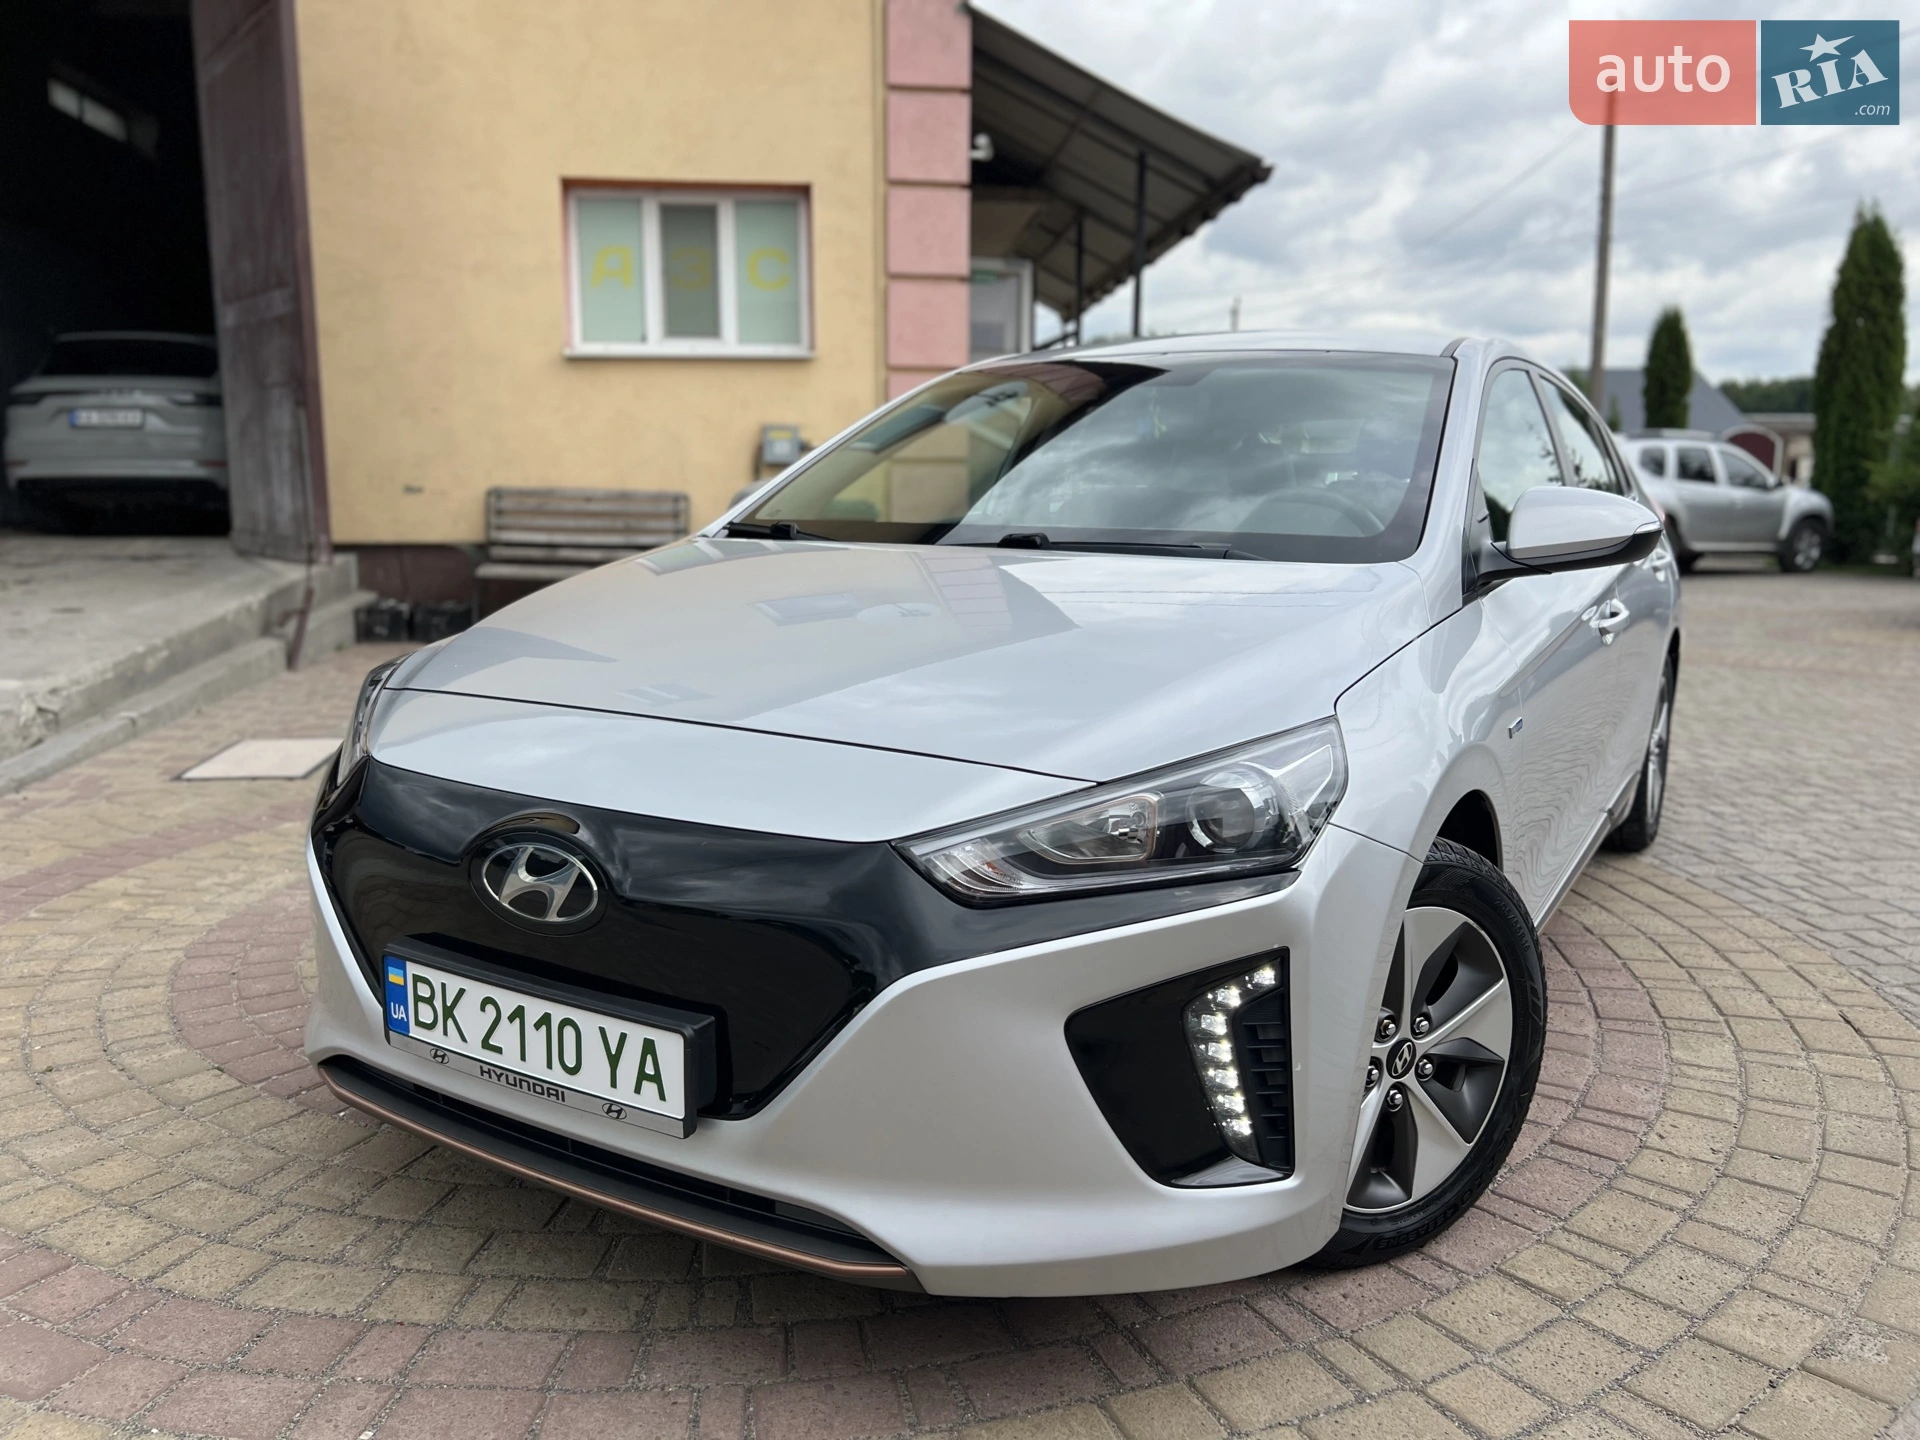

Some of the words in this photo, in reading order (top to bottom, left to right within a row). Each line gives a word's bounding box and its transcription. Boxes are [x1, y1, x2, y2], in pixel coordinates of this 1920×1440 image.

[391, 1001, 408, 1023] UA
[412, 973, 468, 1043] BK
[479, 995, 582, 1077] 2110
[598, 1026, 667, 1102] YA
[479, 1065, 566, 1102] HYUNDAI
